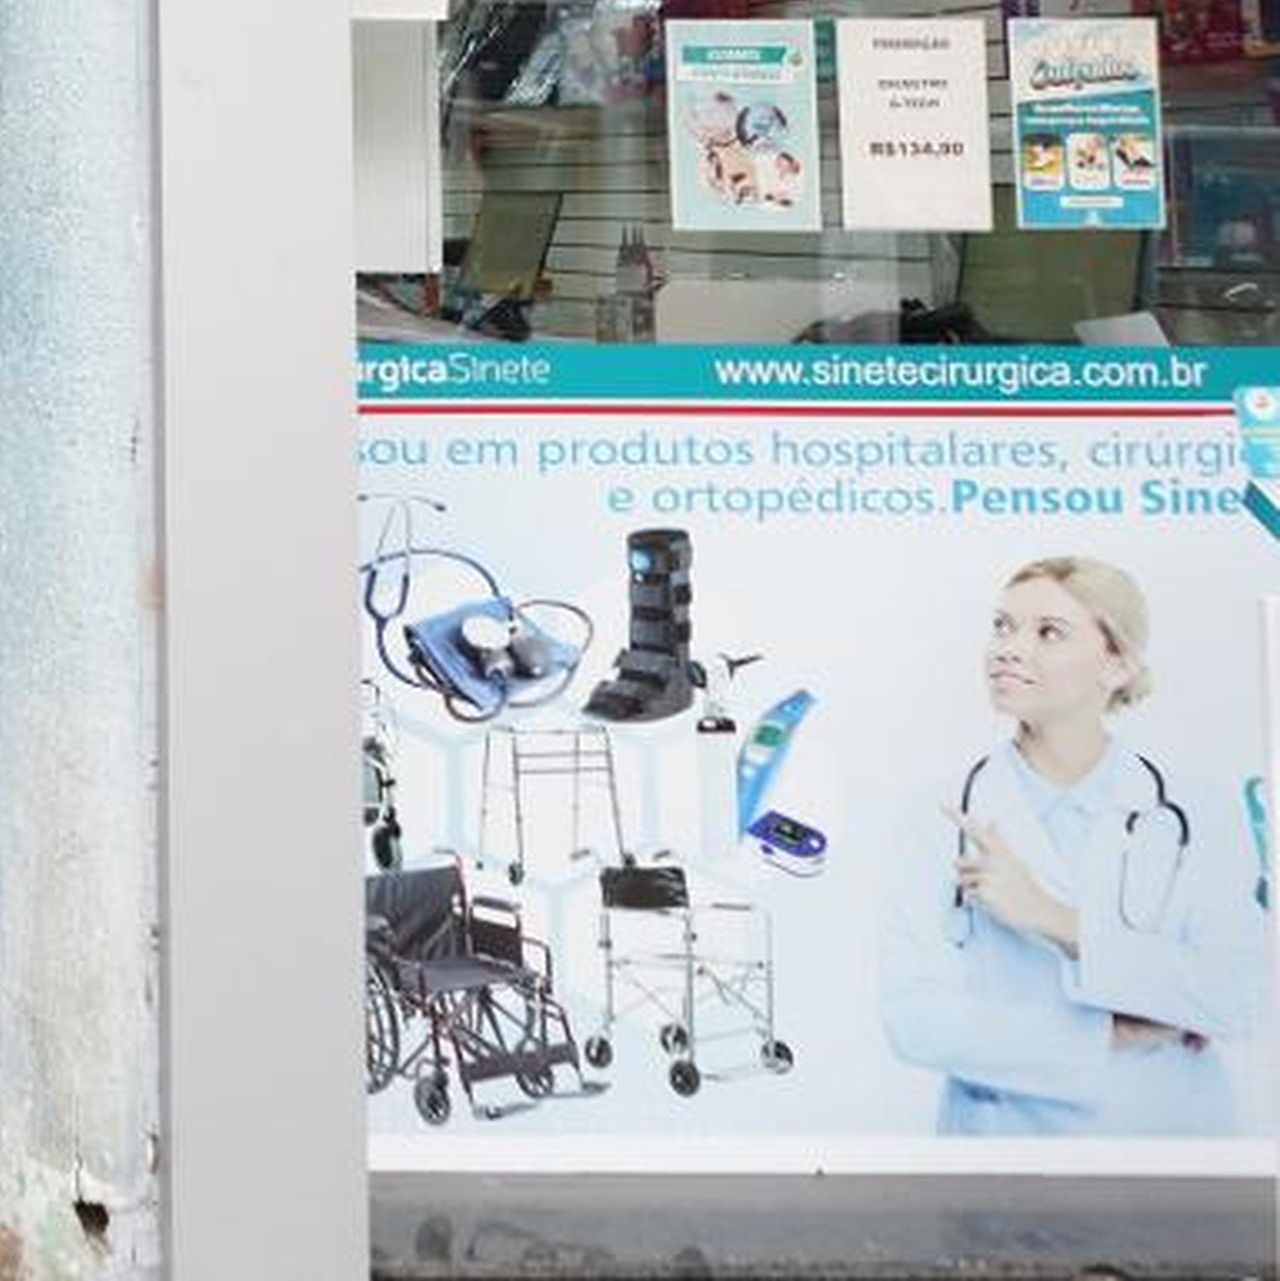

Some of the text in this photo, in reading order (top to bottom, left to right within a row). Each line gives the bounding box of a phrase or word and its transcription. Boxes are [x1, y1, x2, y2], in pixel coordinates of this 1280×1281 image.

[714, 354, 1208, 394] www.sinetecirurgica.com.br
[446, 438, 519, 466] em
[539, 432, 754, 474] produtos
[772, 431, 1070, 477] hospitalares,
[1091, 431, 1248, 477] cirúrgi
[607, 487, 635, 513] e
[952, 478, 1124, 515] Pensou
